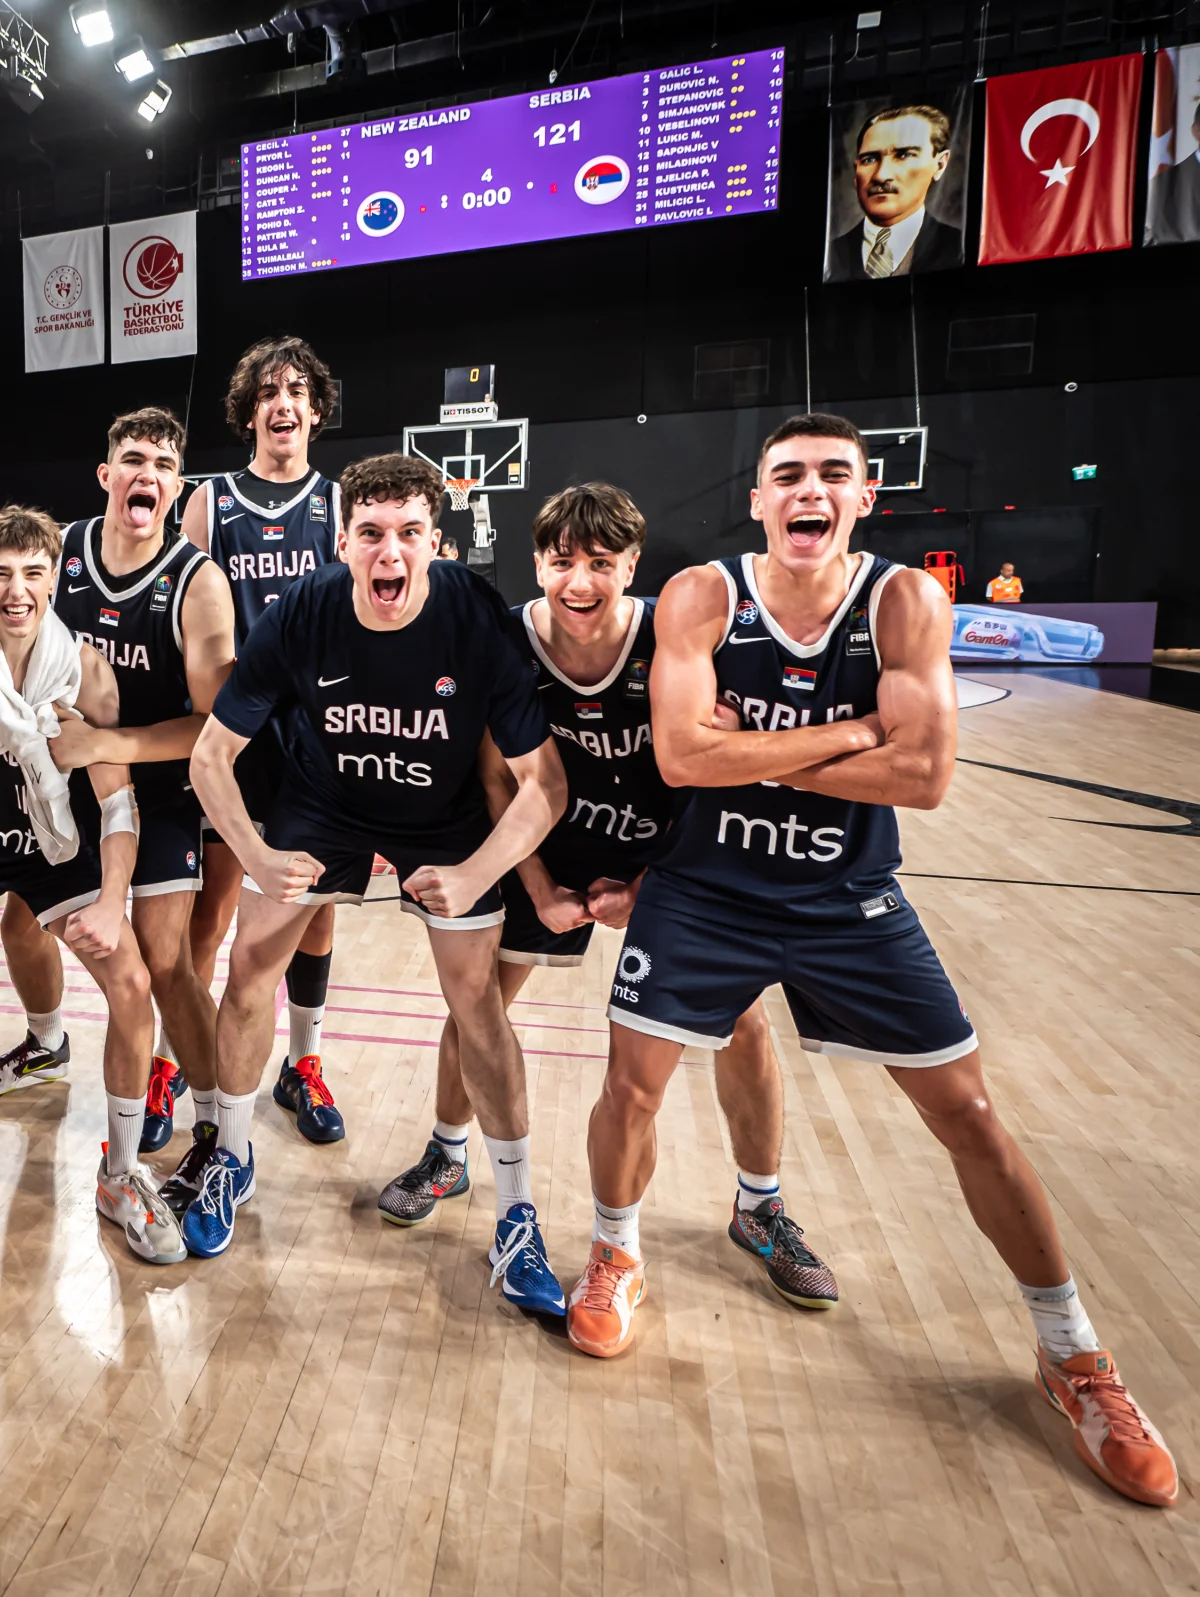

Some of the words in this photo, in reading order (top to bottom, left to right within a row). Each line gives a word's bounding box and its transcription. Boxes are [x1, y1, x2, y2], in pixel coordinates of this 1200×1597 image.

[644, 75, 650, 83] 2
[660, 68, 691, 80] GALIC
[694, 66, 703, 74] L.
[771, 50, 784, 60] 10
[643, 88, 648, 96] 3
[659, 78, 705, 94] DUROVIC
[708, 76, 719, 85] N.
[773, 64, 780, 73] 4
[529, 86, 591, 109] SERBIA
[642, 101, 648, 109] 7
[659, 88, 724, 106] STEPANOVIC
[769, 78, 783, 87] 10
[639, 126, 650, 135] 10
[658, 115, 720, 132] VESELINOVI
[771, 106, 778, 114] 2
[642, 114, 648, 122] 9
[658, 100, 726, 119] SIMJANOVSK
[361, 122, 395, 138] NEW
[398, 108, 470, 132] ZEALAND
[638, 139, 649, 147] 11
[657, 132, 688, 145] LUKIC
[691, 131, 703, 139] M.
[768, 118, 780, 128] 11
[256, 142, 279, 151] CECIL
[341, 128, 350, 136] 37
[533, 120, 581, 147] 121
[256, 152, 282, 163] PRYOR
[404, 146, 433, 168] 91
[638, 152, 649, 160] 12
[657, 142, 708, 158] SAPONJIC
[656, 154, 717, 170] MILADINOVI
[769, 146, 776, 154] 4
[256, 163, 284, 174] KEOGH
[341, 152, 350, 160] 11
[256, 174, 290, 185] DUNCAN
[481, 168, 493, 182] 4
[636, 178, 648, 186] 22
[656, 171, 699, 184] BJELICA
[702, 169, 709, 177] P.
[655, 181, 715, 196] KUSTURICA
[764, 172, 778, 181] 27
[256, 185, 289, 197] COUPER
[462, 187, 511, 210] 0:00
[636, 203, 647, 212] 31
[655, 196, 693, 209] MILICIC
[696, 195, 705, 203] L.
[764, 185, 776, 194] 11
[256, 198, 277, 208] CATE
[257, 207, 295, 219] RAMPTON
[654, 208, 703, 222] PAVLOVIC
[707, 207, 713, 215] L
[764, 198, 775, 208] 11
[257, 220, 282, 231] POHIO
[257, 231, 286, 242] PATTEN
[343, 222, 348, 230] 2
[257, 243, 277, 253] SULA
[257, 251, 304, 264] TUIMALEALI
[257, 264, 296, 275] THOMSON
[298, 262, 307, 270] M.
[36, 316, 48, 324] T.C.
[50, 311, 81, 323] GENÇLİK
[83, 309, 91, 317] VE
[124, 299, 184, 318] TÜRKİYE
[34, 324, 53, 334] SPOR
[55, 319, 94, 331] BAKANLIĞI
[124, 313, 184, 328] BASKETBOL
[124, 322, 184, 336] FEDERASYONU
[470, 368, 479, 382] 0
[229, 550, 315, 581] SRBIJA
[850, 633, 869, 642] FIBA
[628, 683, 644, 691] FIBA
[325, 704, 449, 739] SRBIJA
[338, 752, 432, 786] mts
[569, 798, 658, 842] mts
[718, 810, 845, 862] mts
[888, 898, 895, 906] L
[612, 984, 639, 1003] mts
